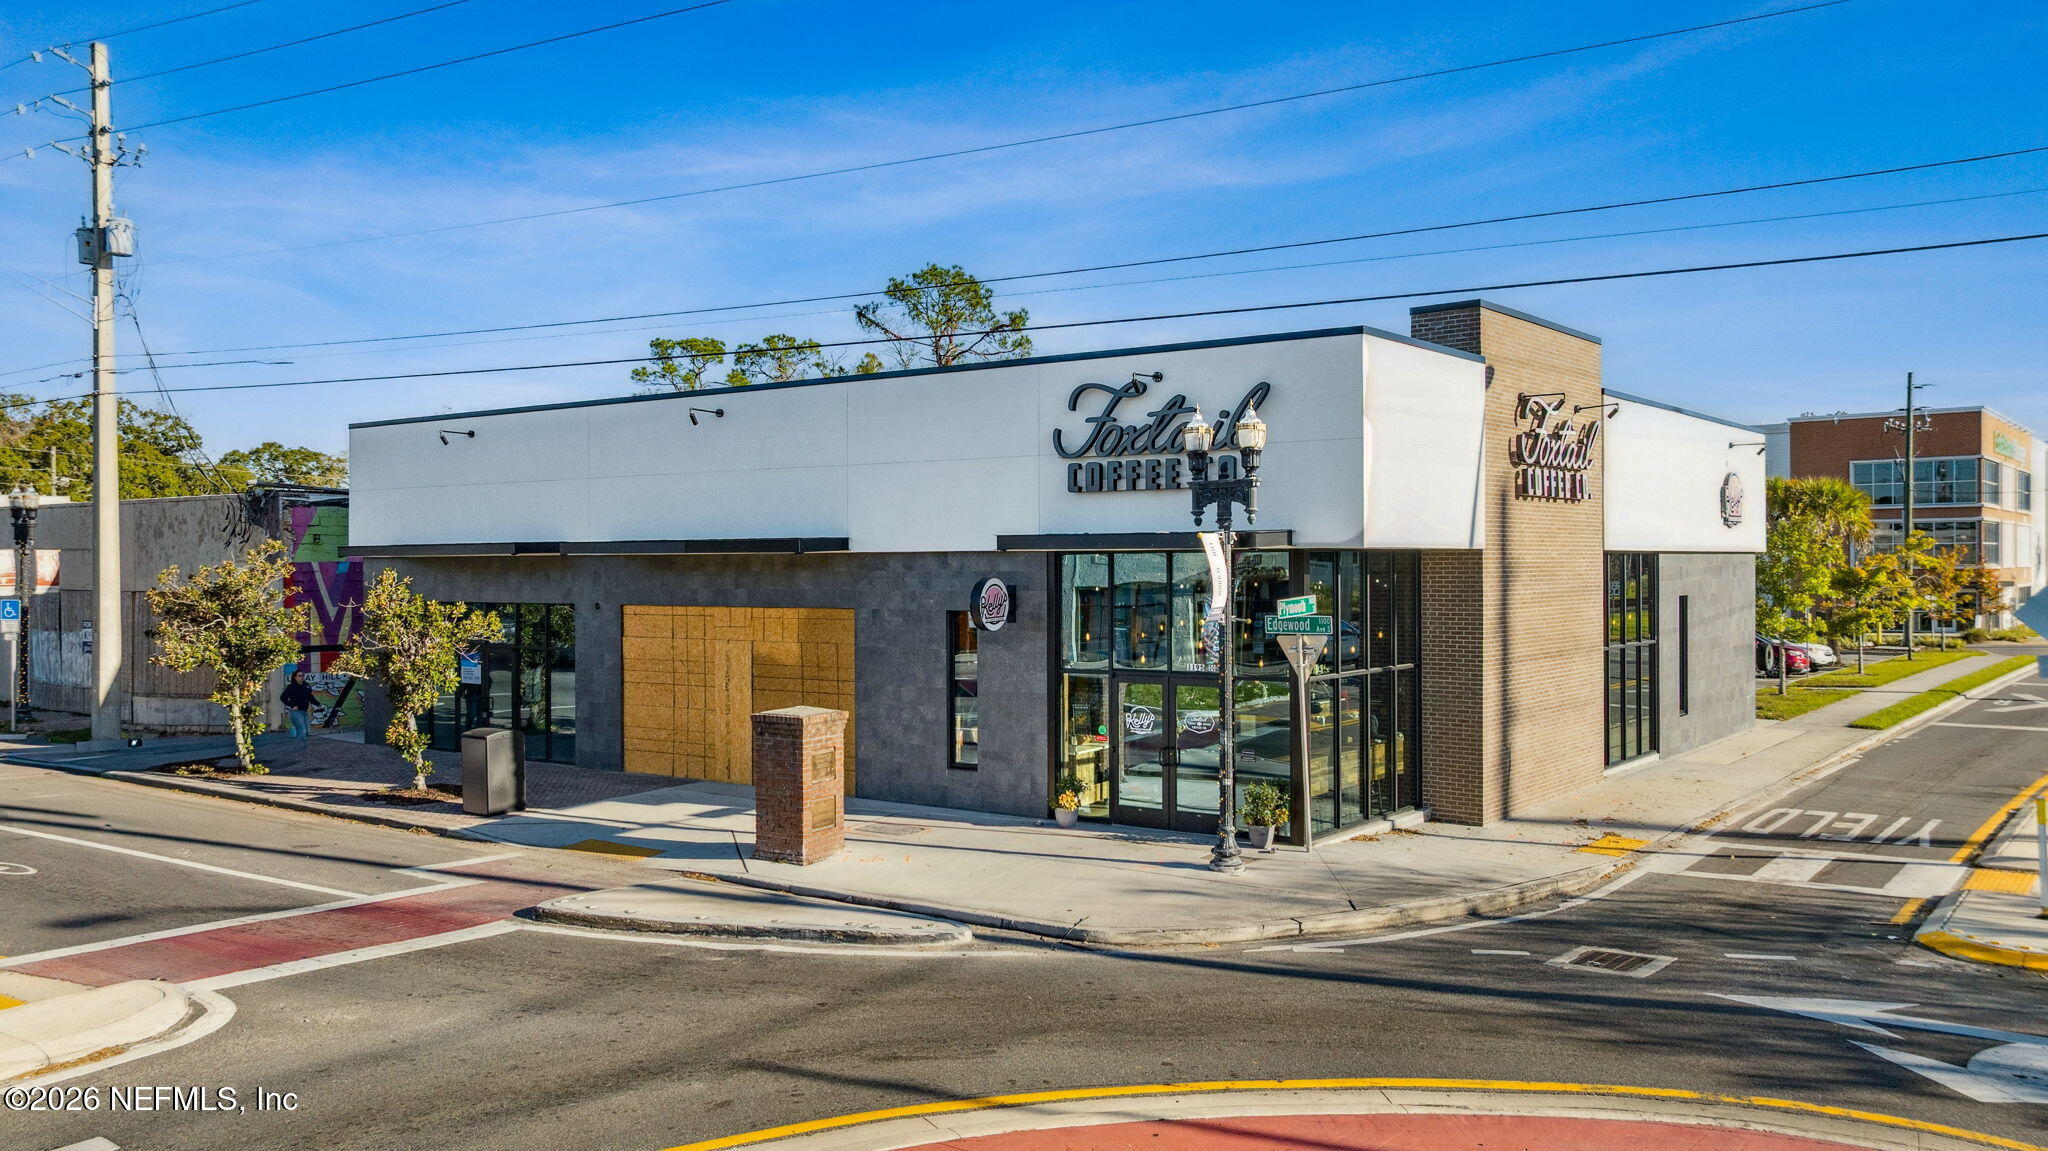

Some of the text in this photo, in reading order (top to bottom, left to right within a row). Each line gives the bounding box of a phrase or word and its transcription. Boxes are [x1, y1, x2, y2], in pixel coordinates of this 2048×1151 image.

[1053, 381, 1271, 458] Foxtail
[1519, 396, 1600, 470] Foxtail
[1067, 457, 1181, 493] COFFEE
[1526, 467, 1571, 499] COFFEE
[1267, 617, 1310, 632] Edgewood
[1742, 807, 1943, 848] YIELD
